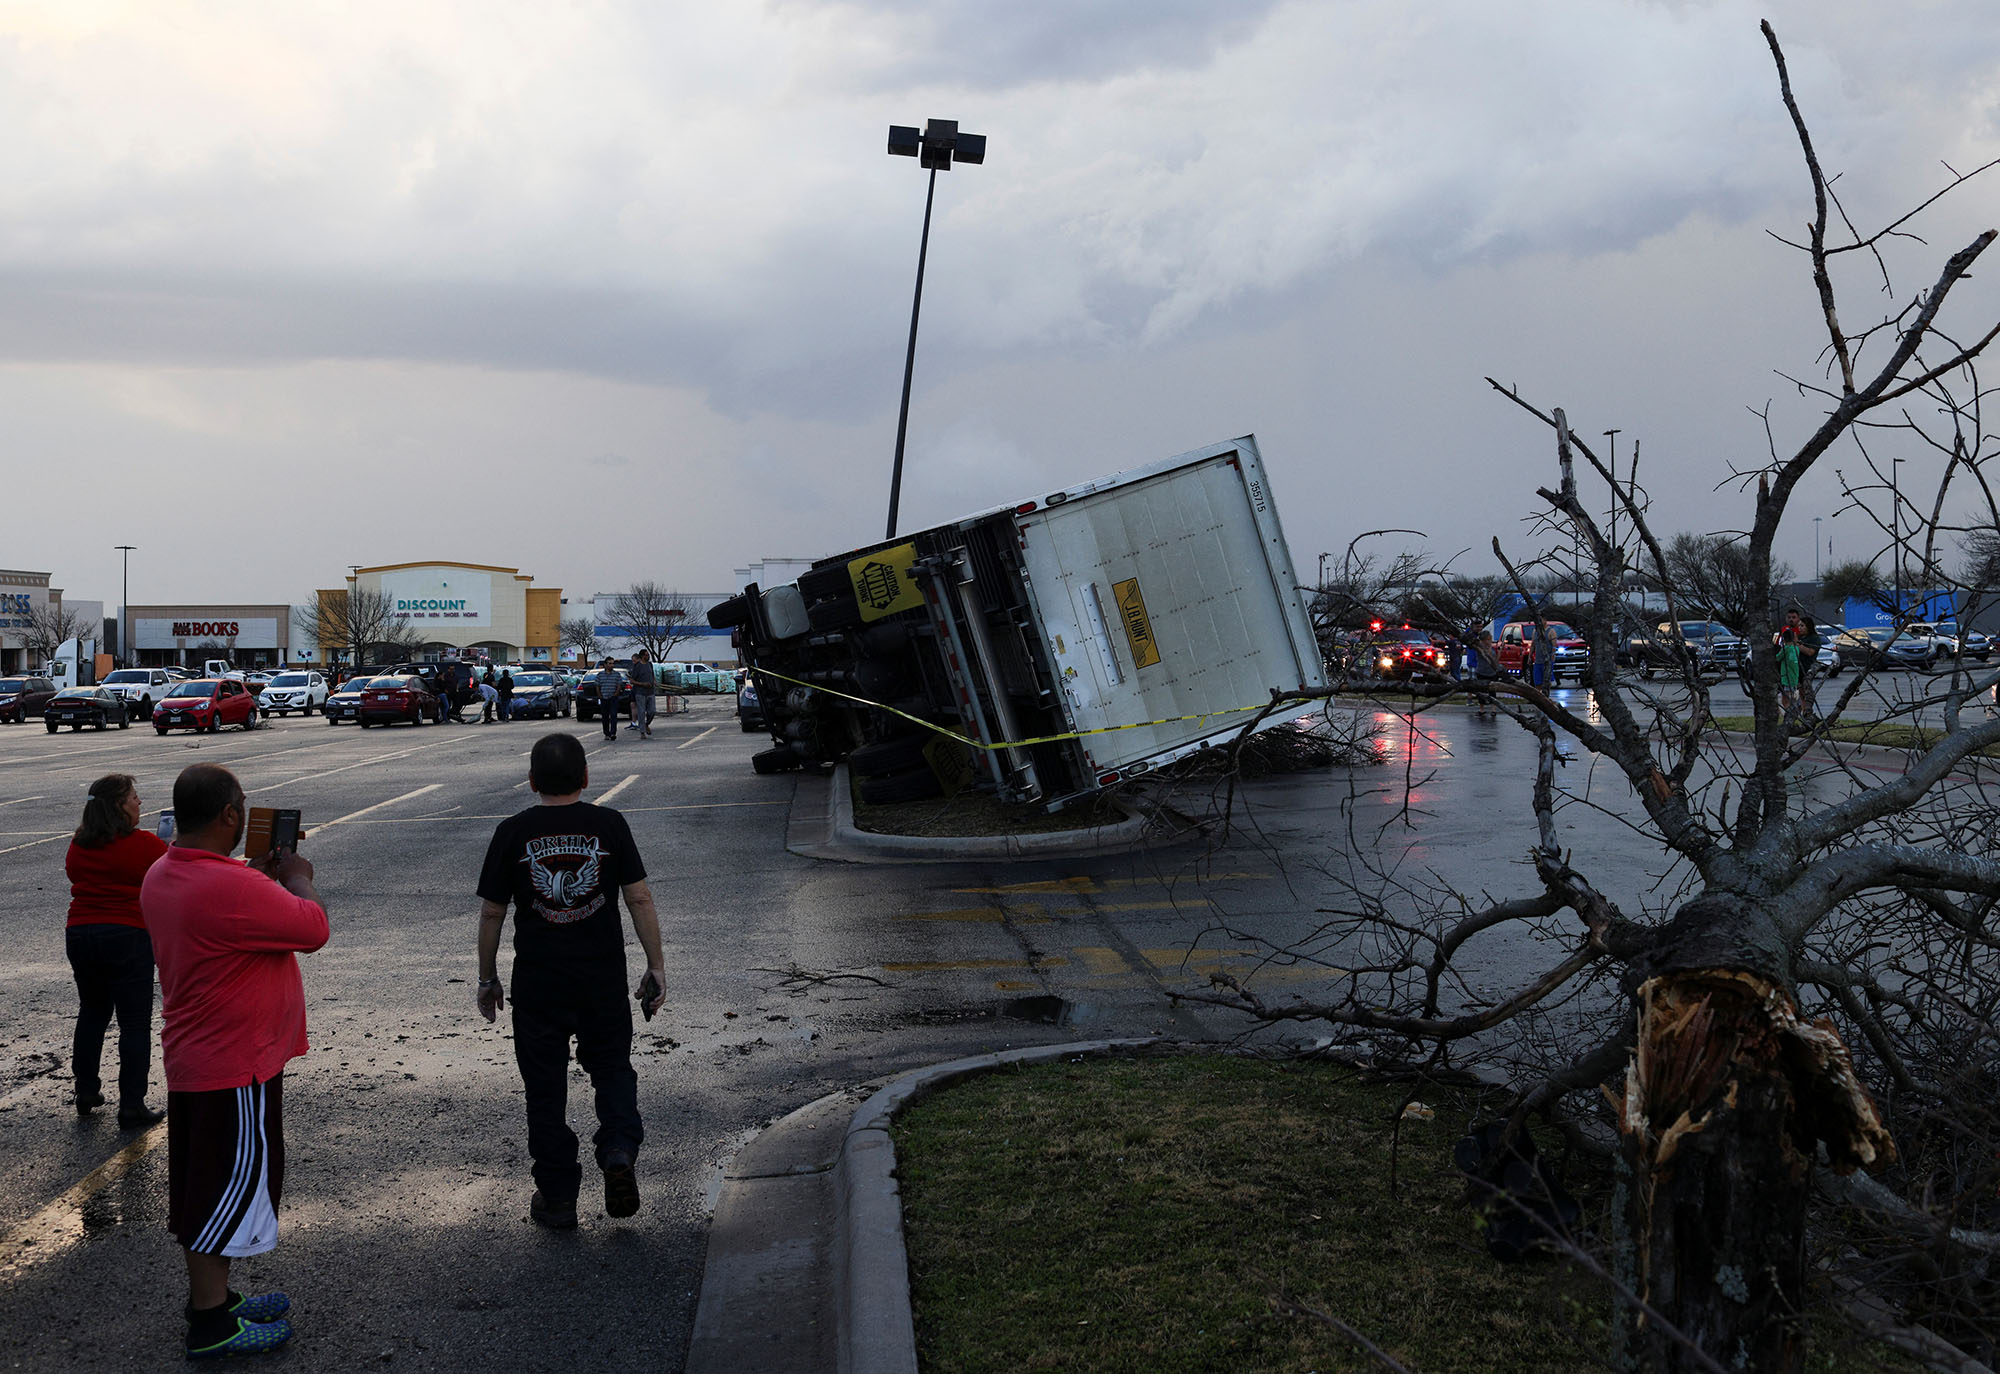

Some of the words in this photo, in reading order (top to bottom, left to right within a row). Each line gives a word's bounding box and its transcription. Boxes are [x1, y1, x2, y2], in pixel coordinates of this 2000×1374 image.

[1250, 480, 1266, 512] 355715
[856, 578, 869, 603] TURNS
[862, 562, 893, 609] WIDE
[884, 565, 901, 597] CAUTION
[398, 599, 466, 610] DISCOUNT
[192, 621, 239, 637] BOOKS
[1130, 618, 1148, 642] HUNT
[528, 835, 598, 854] DREAM
[532, 893, 606, 924] MOTORCYCLES
